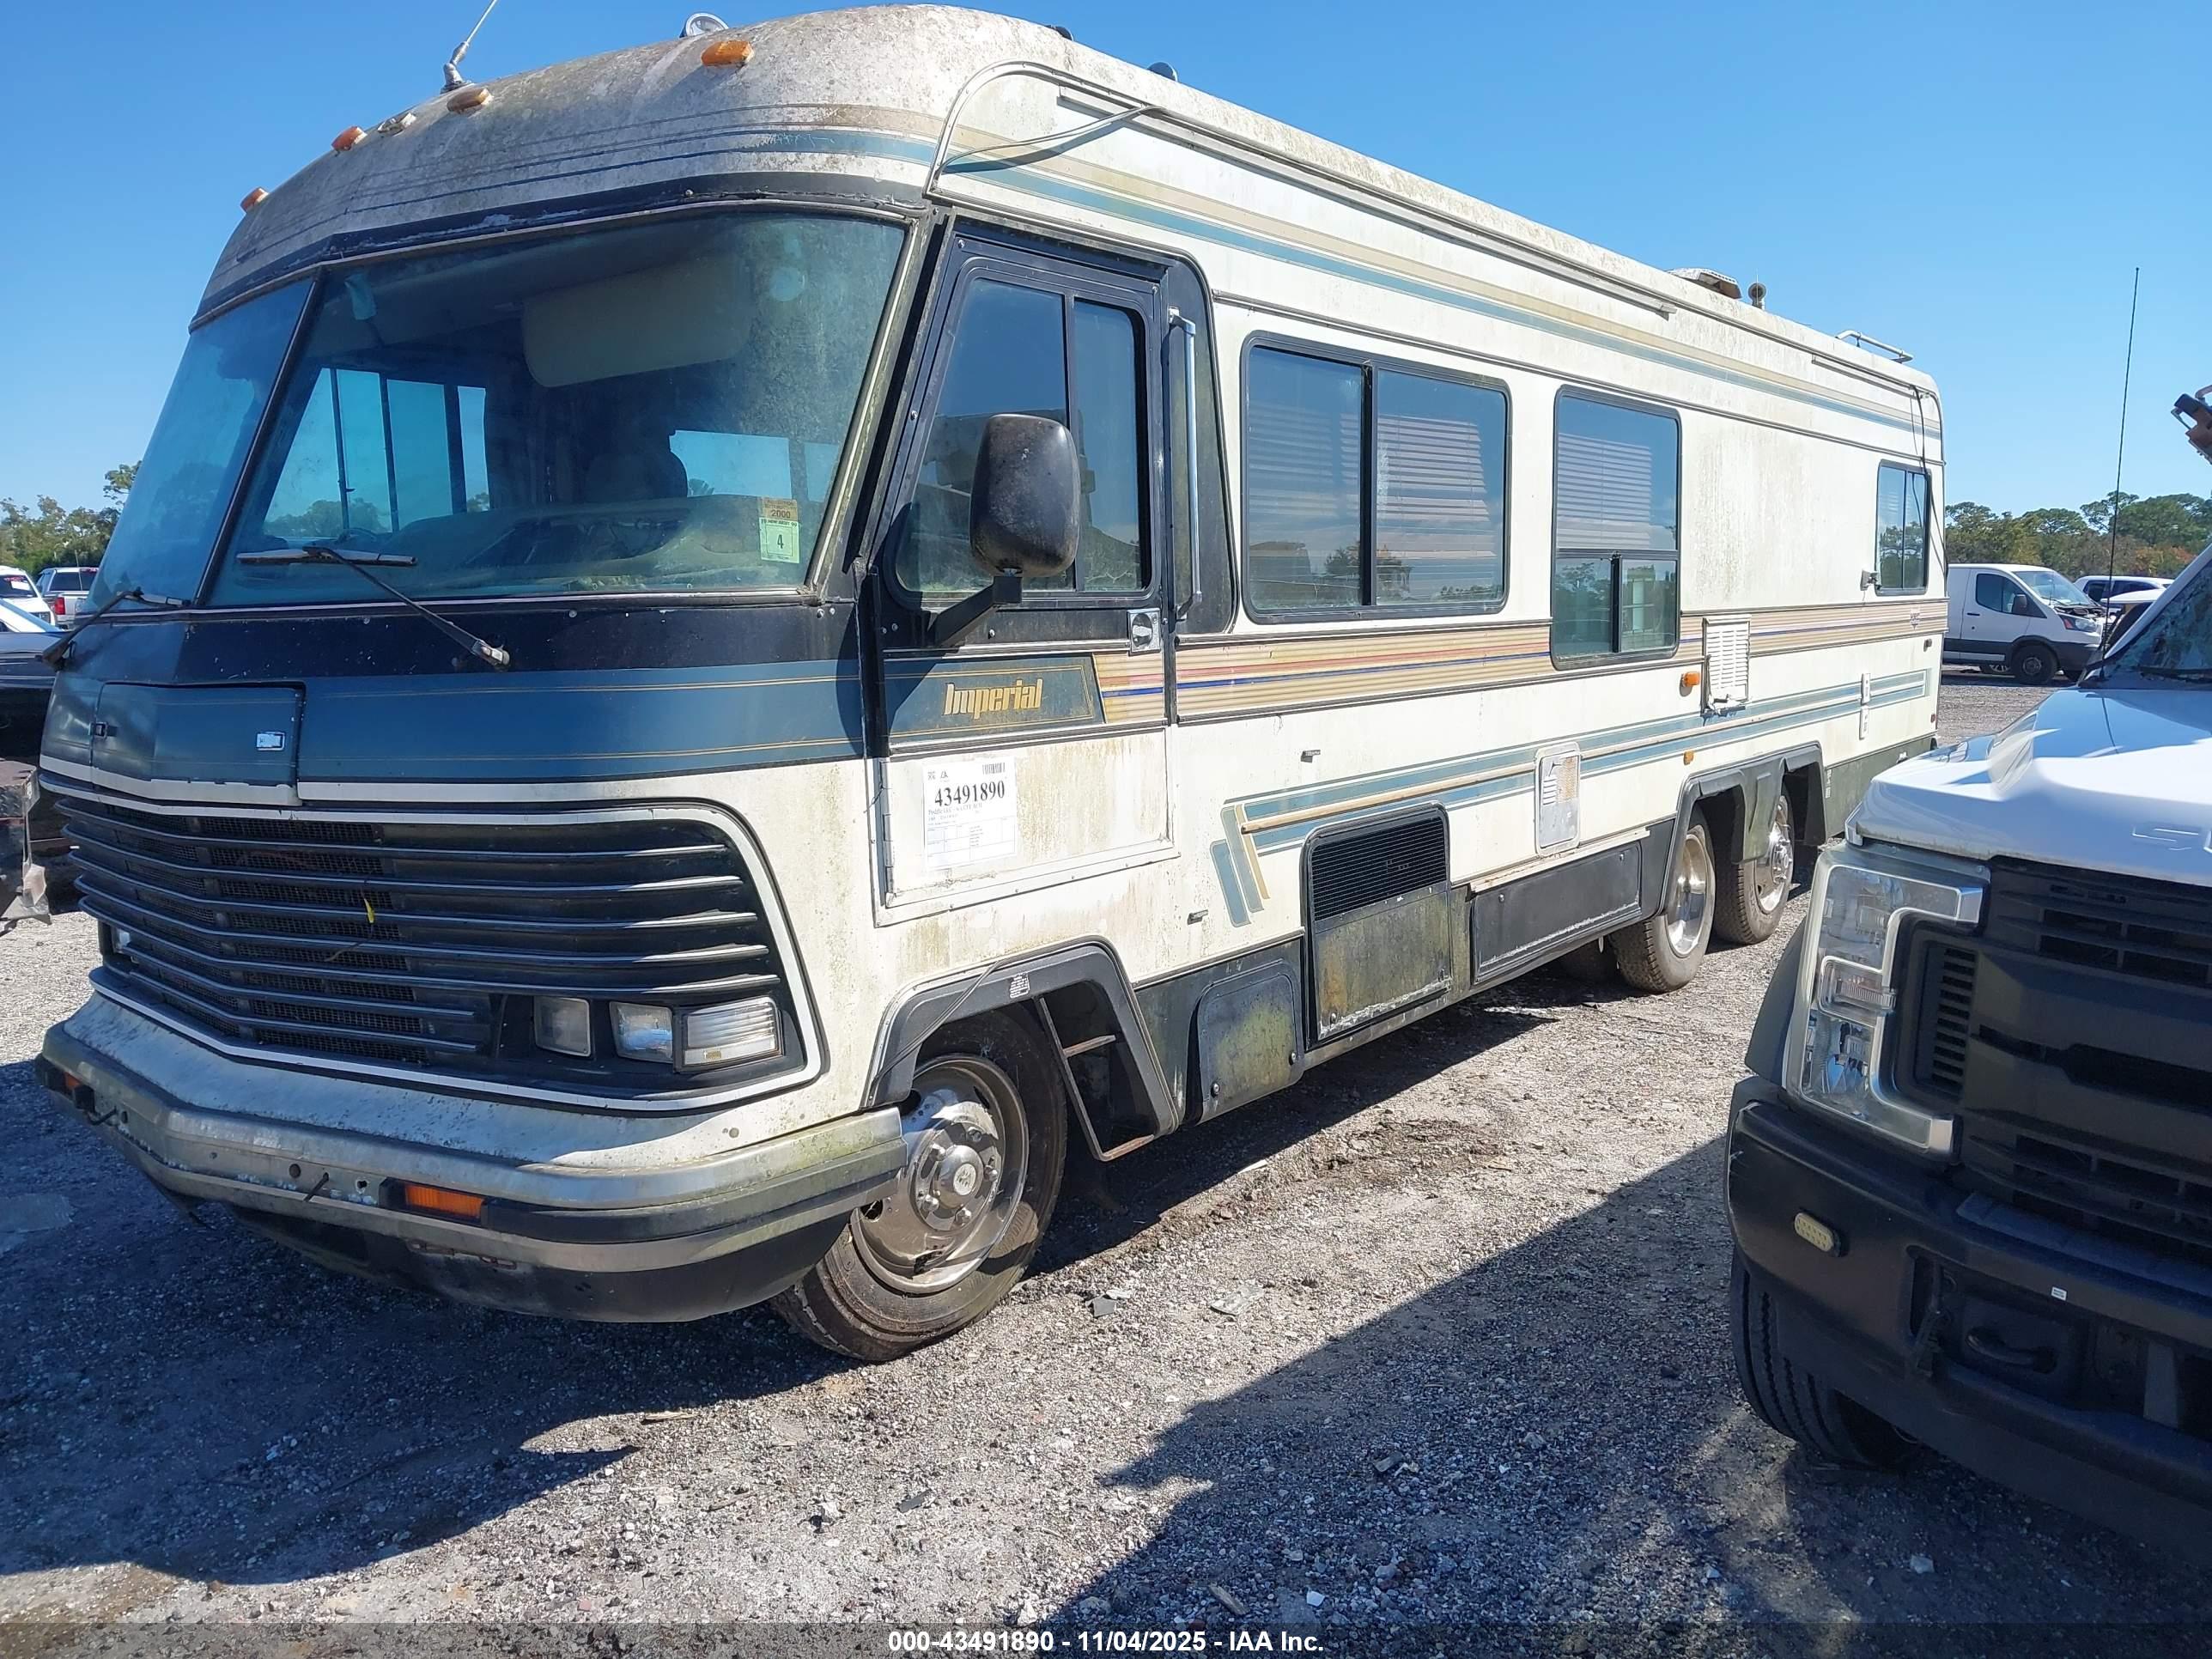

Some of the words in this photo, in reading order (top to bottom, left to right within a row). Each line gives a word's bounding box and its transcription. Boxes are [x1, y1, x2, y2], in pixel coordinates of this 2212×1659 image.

[771, 510, 790, 519] 2000
[777, 534, 784, 549] 4
[943, 678, 1043, 720] Imperial
[934, 780, 1005, 807] 43491890
